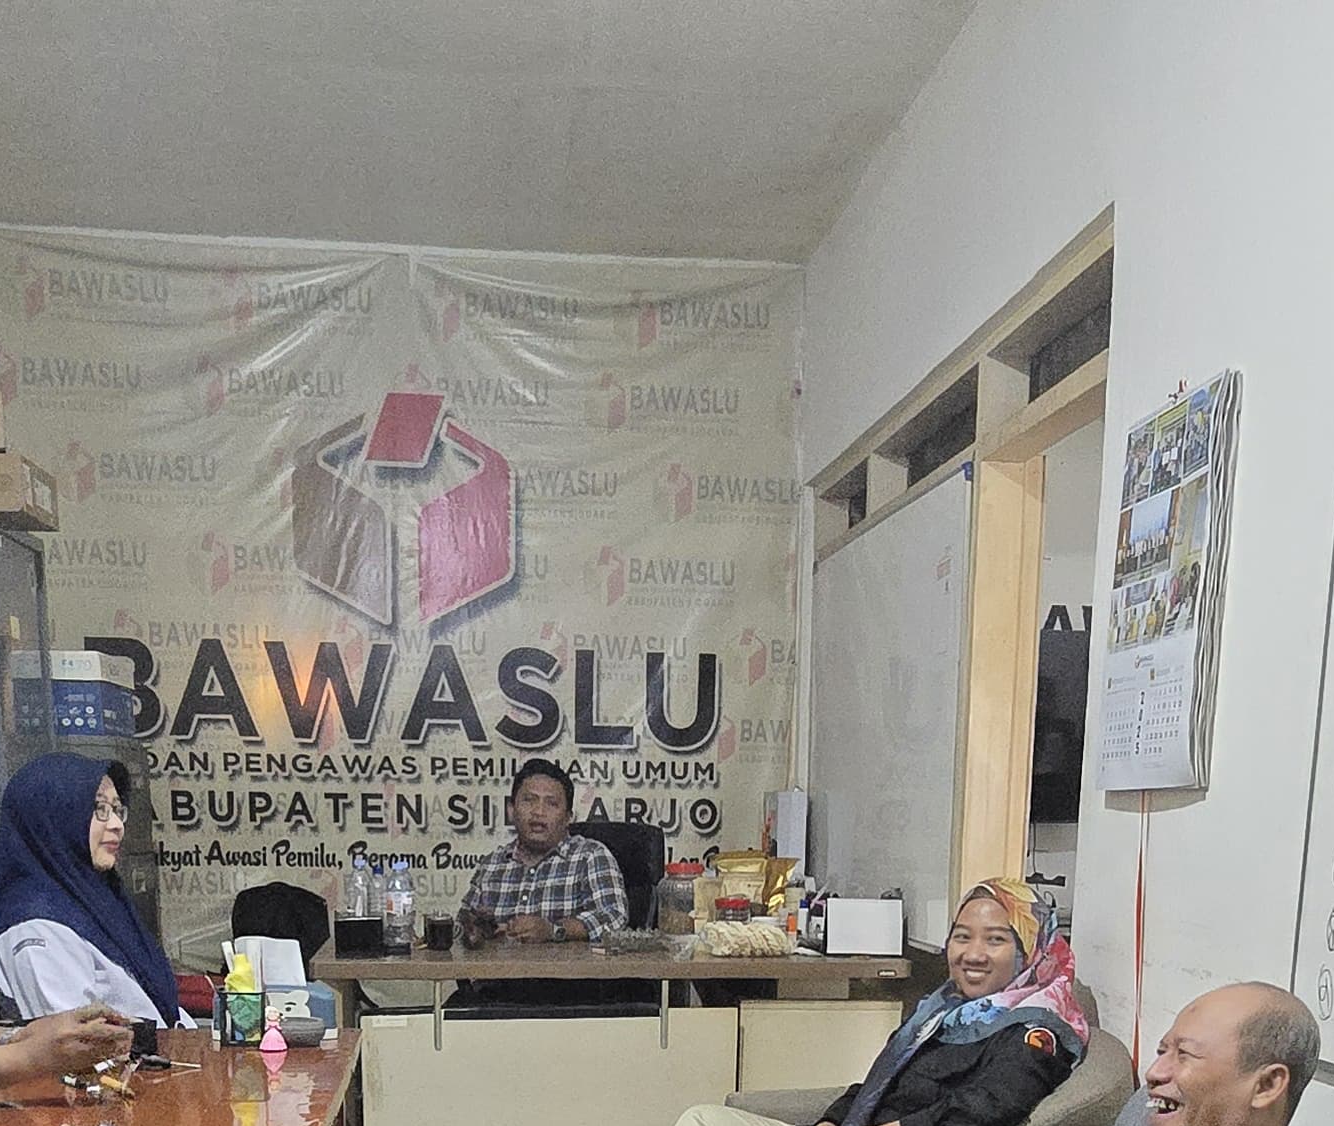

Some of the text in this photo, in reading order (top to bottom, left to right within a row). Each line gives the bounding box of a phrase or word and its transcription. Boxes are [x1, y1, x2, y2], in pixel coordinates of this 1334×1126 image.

[48, 268, 167, 303] BAWASLU
[256, 277, 372, 314] BAWASLU
[659, 300, 770, 330] BAWASLU
[21, 356, 142, 389] BAWASLU
[226, 369, 345, 399] BAWASLU
[629, 383, 739, 414] BAWASLU
[99, 451, 218, 482] BAWASLU
[517, 468, 618, 498] AWASLU
[47, 538, 147, 568] AWASLU
[628, 558, 736, 587] BAWASLU
[84, 635, 718, 748] BAWASLU
[147, 750, 209, 772] DAN
[223, 752, 418, 776] PENGAWAS
[622, 760, 716, 782] UMUM
[150, 788, 718, 831] BUPATEN SIARJO
[155, 840, 202, 873] kyat
[203, 839, 268, 868] Awasi
[271, 839, 343, 870] Pemilu,
